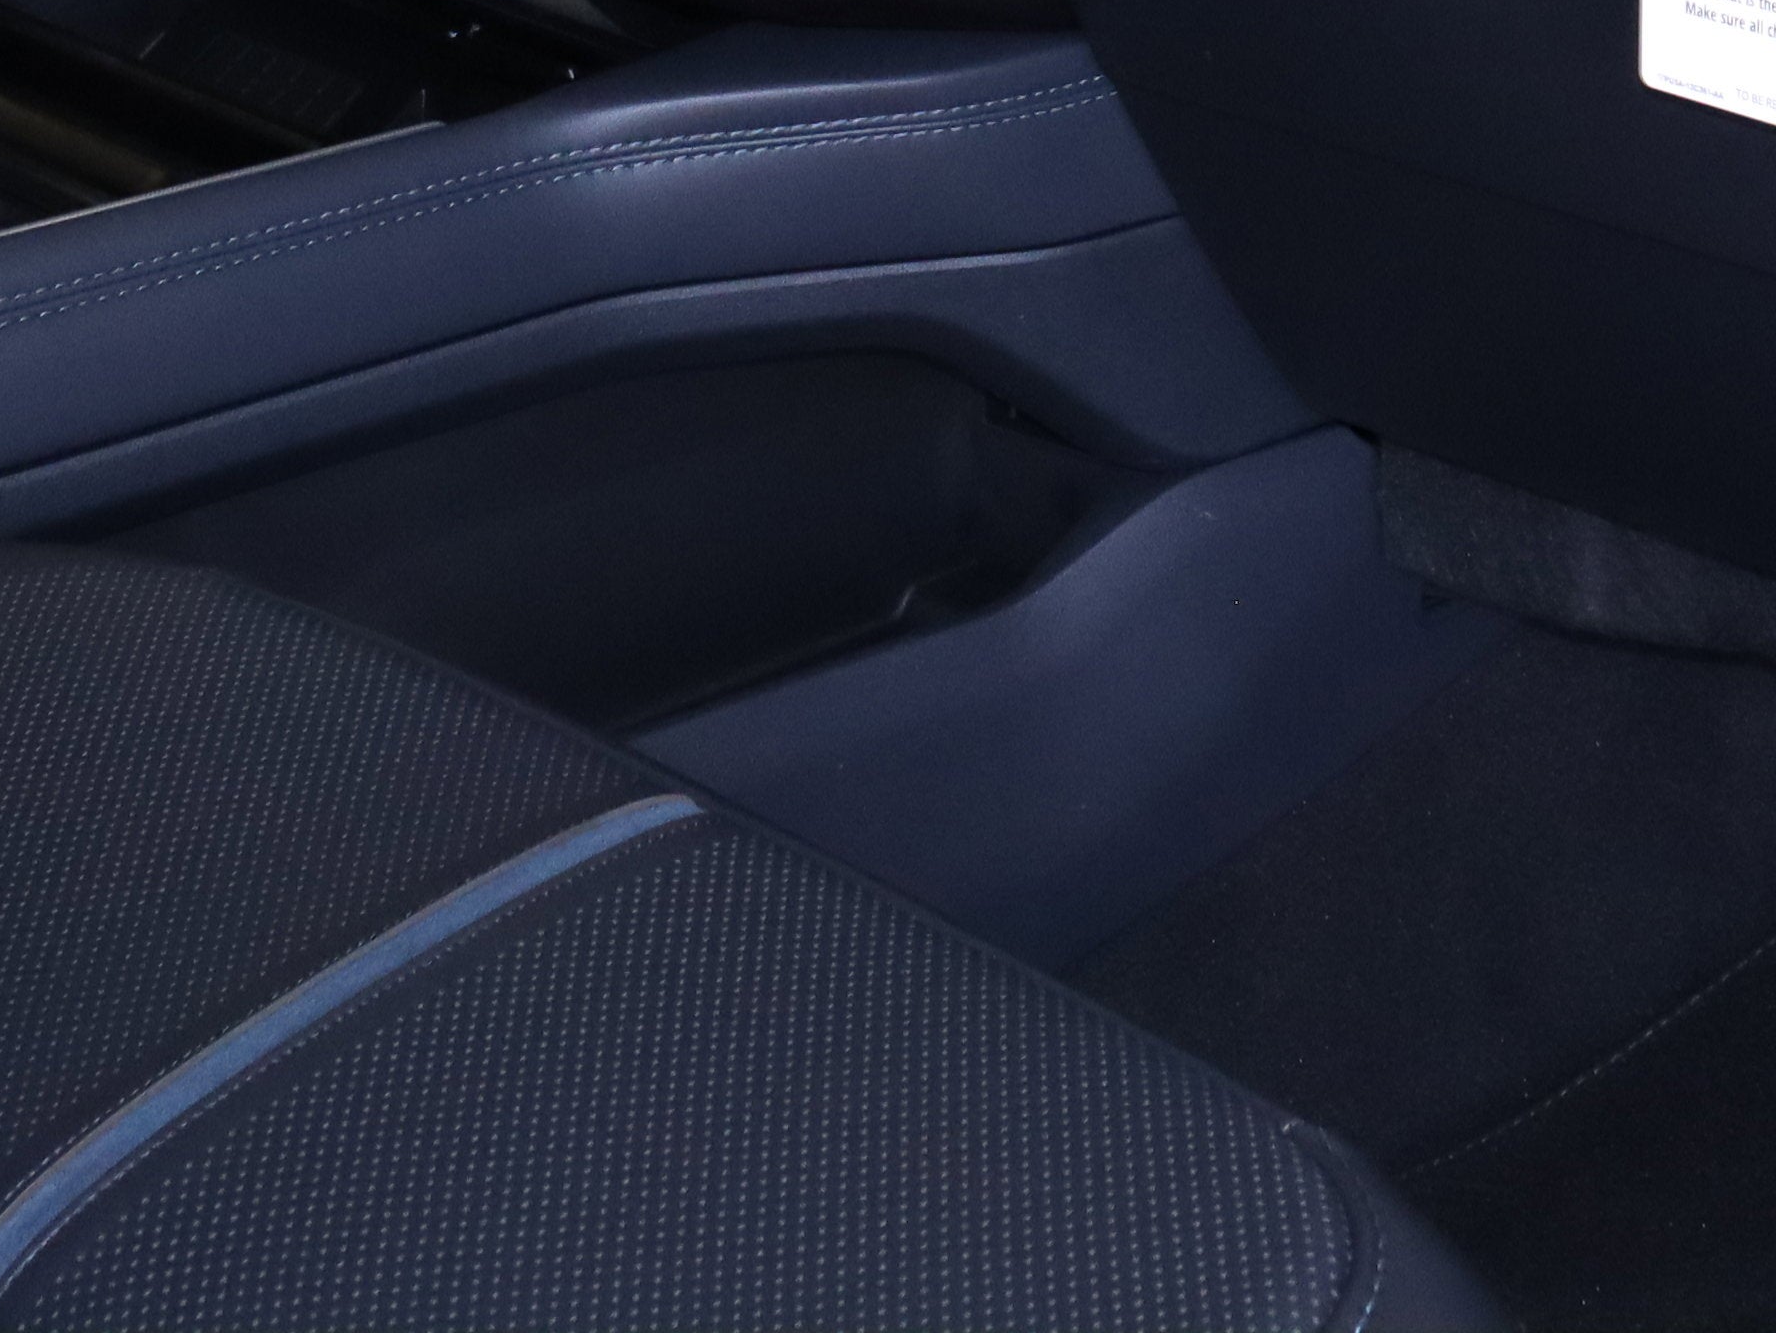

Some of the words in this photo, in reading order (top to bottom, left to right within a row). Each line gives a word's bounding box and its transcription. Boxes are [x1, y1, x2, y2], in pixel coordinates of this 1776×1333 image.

[1684, 0, 1718, 22] Make
[1720, 13, 1747, 30] sure
[1749, 20, 1763, 36] all
[1735, 87, 1751, 101] TO
[1751, 93, 1765, 106] BE
